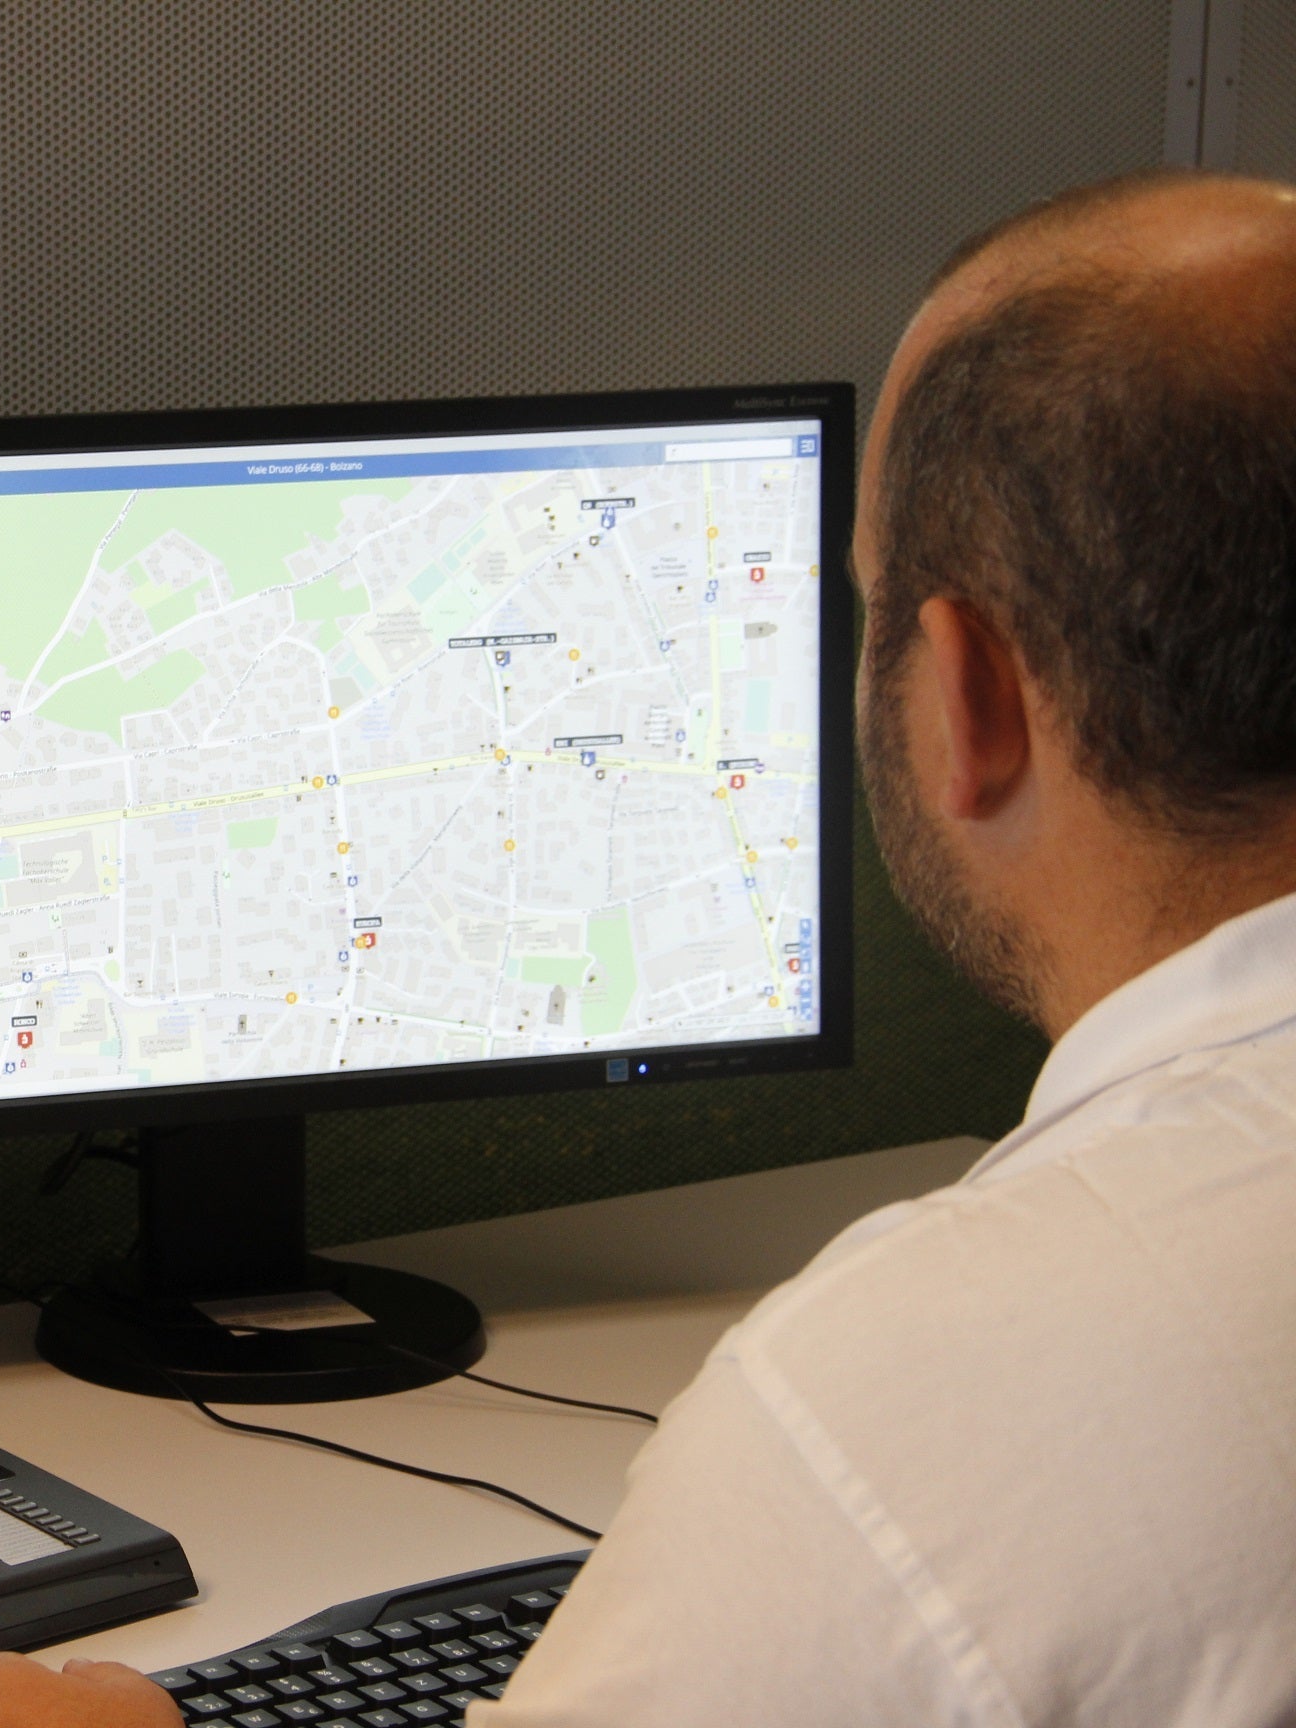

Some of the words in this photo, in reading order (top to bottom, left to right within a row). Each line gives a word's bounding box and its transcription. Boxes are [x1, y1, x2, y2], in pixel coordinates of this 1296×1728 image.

[247, 466, 267, 475] Viale
[268, 464, 294, 475] Druso
[295, 462, 324, 475] (66-68)
[330, 461, 363, 472] Bolzano
